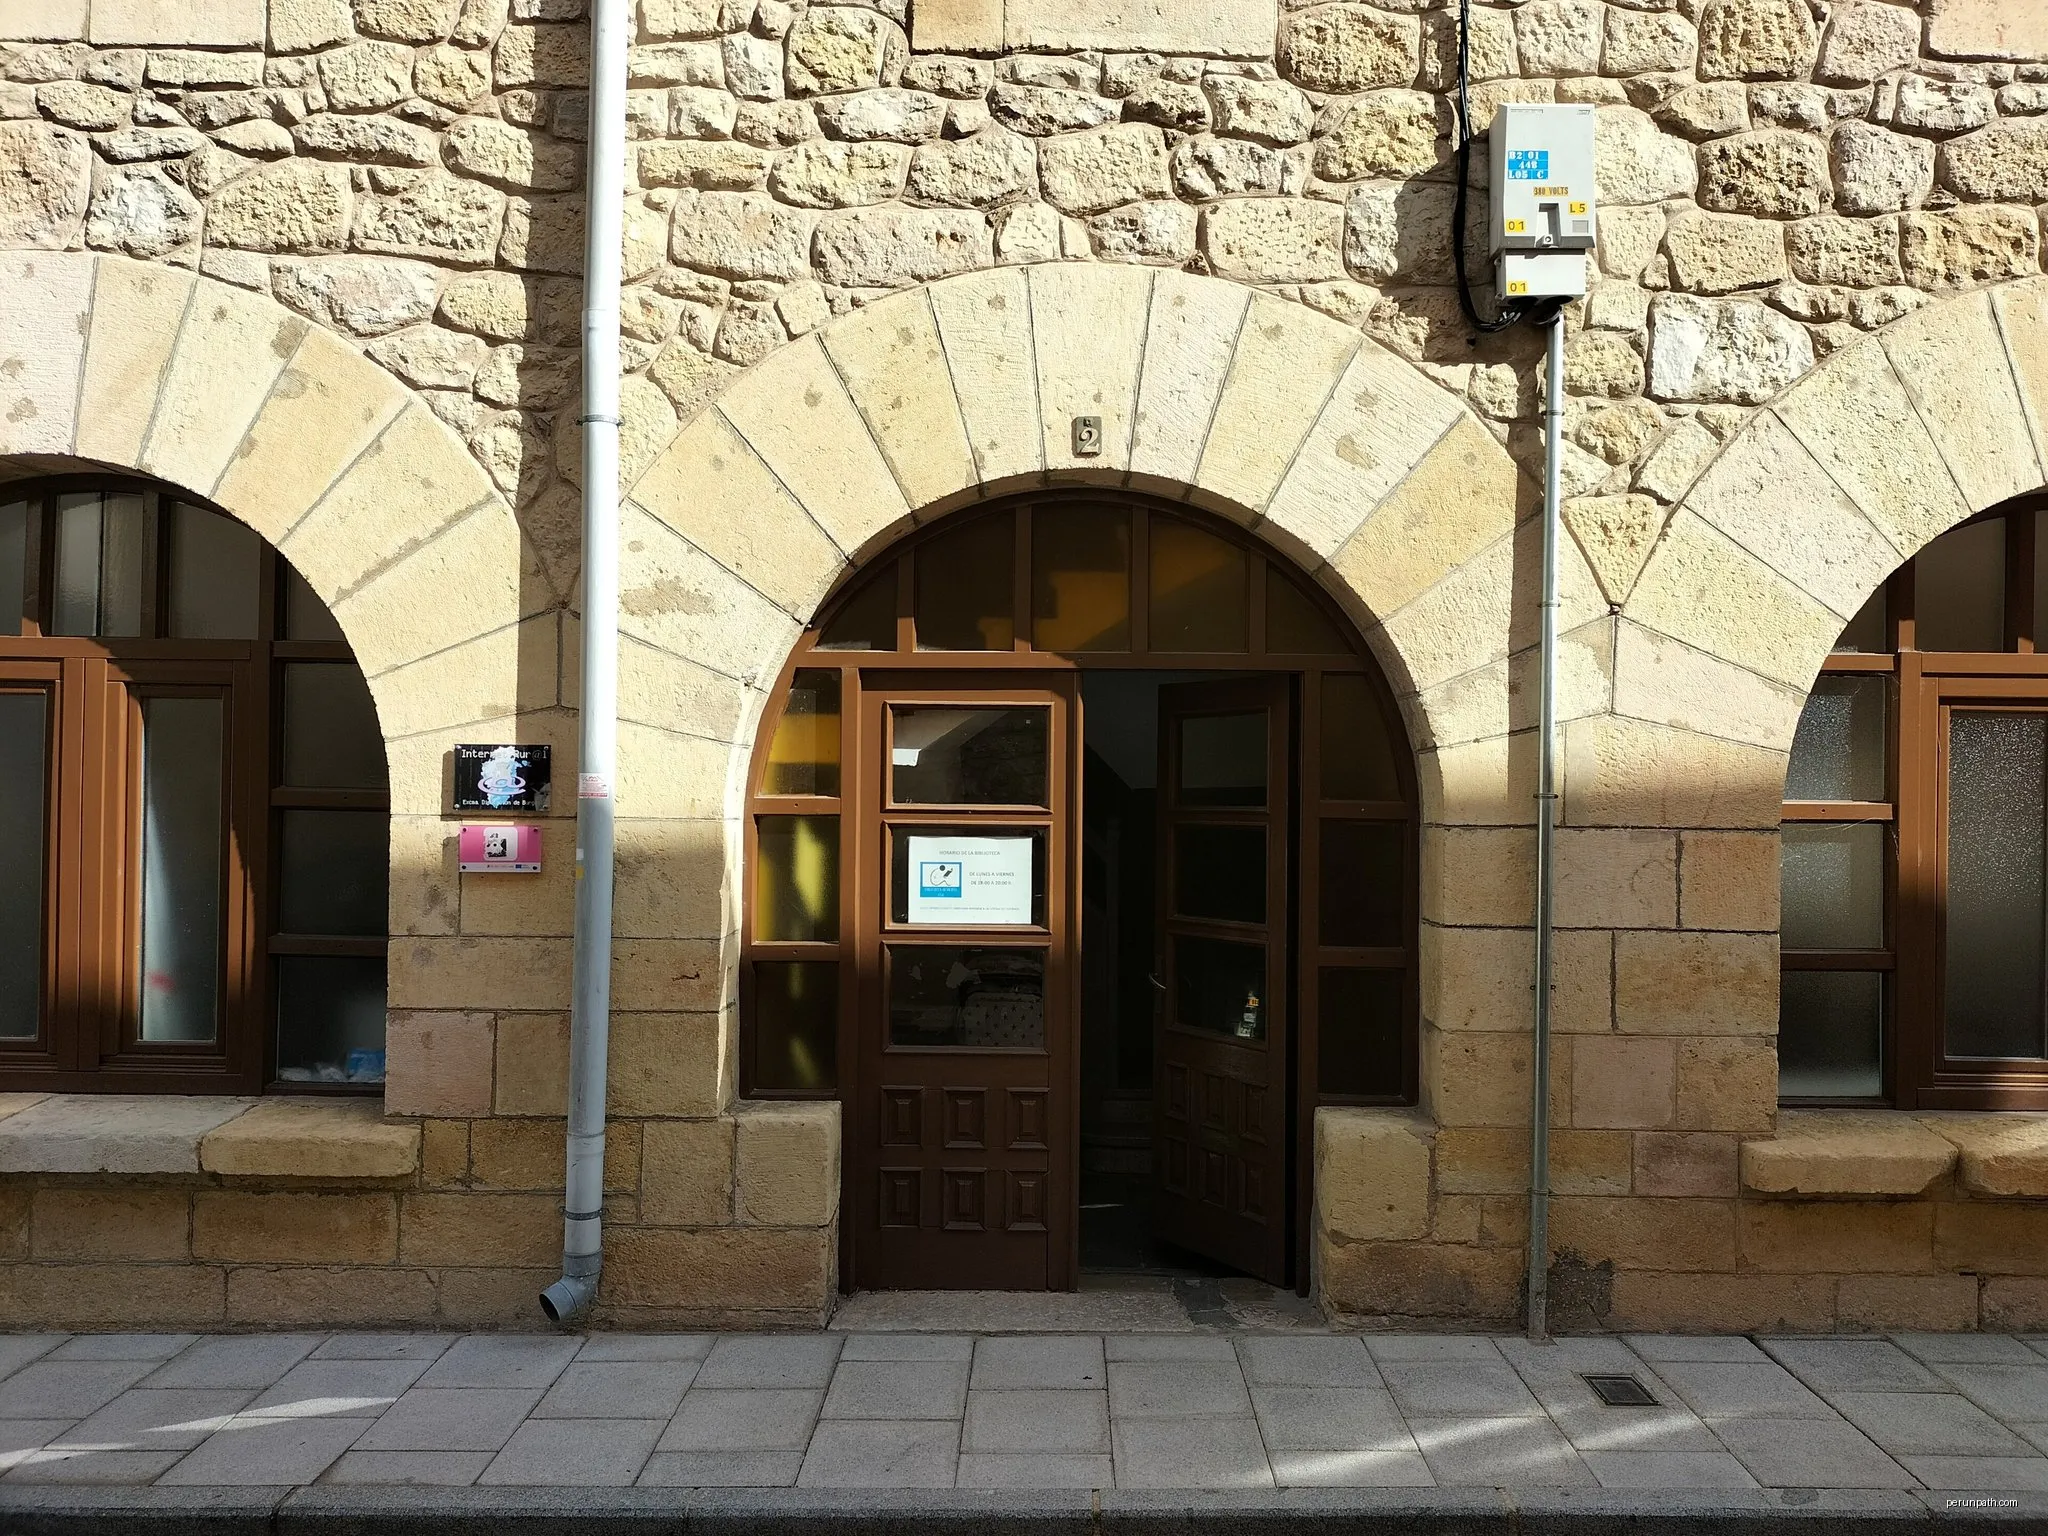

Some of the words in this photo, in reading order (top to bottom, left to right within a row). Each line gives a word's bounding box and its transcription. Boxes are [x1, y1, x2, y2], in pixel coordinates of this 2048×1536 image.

[1508, 170, 1528, 179] L05
[1537, 170, 1544, 179] C
[1534, 186, 1546, 196] 380
[1549, 186, 1568, 195] VOLTS
[1079, 427, 1099, 454] 2
